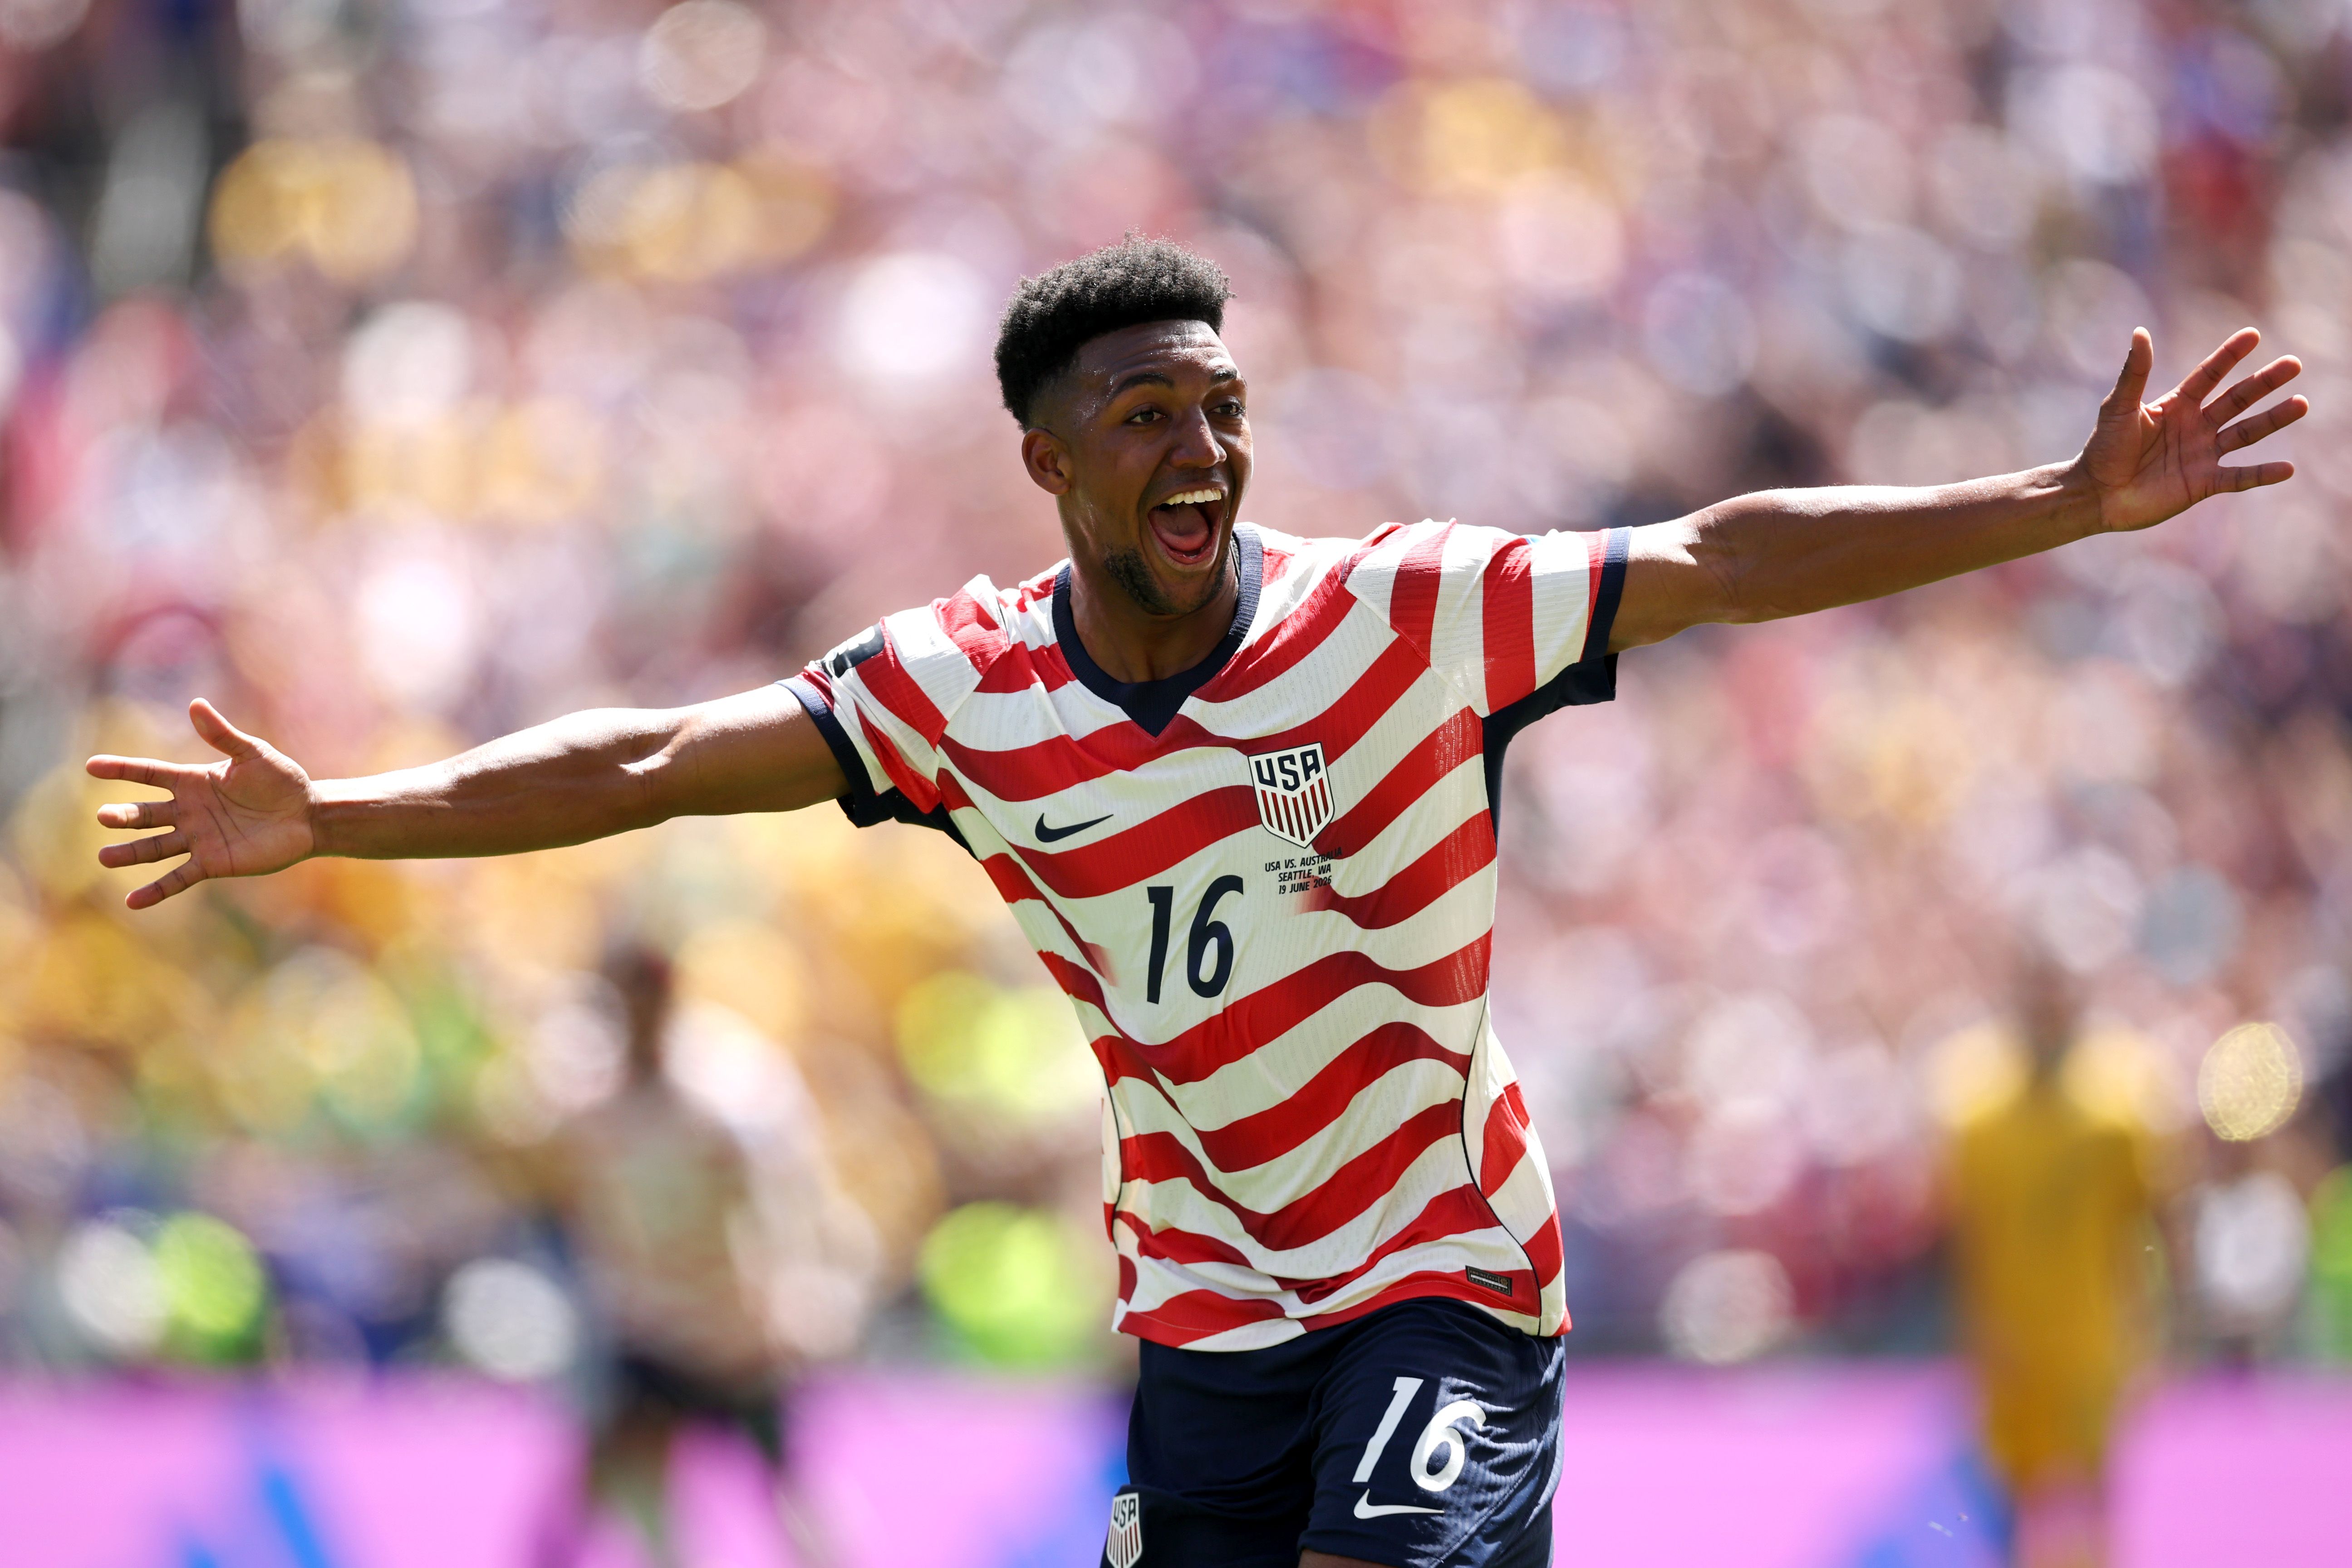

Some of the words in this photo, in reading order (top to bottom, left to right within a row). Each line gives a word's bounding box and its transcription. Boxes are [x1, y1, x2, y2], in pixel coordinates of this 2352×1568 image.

[1255, 749, 1321, 791] USA
[1265, 861, 1281, 872] USA
[1284, 859, 1296, 869] VS.
[1300, 847, 1342, 867] AUSTRALIA
[1278, 869, 1315, 882] SEATTLE,
[1318, 864, 1331, 875] WA
[1279, 885, 1286, 895] 19
[1289, 881, 1310, 893] JUNE
[1313, 875, 1332, 888] 2026
[1147, 875, 1244, 1004] 16
[1352, 1376, 1487, 1492] 16
[1114, 1498, 1136, 1528] USA
